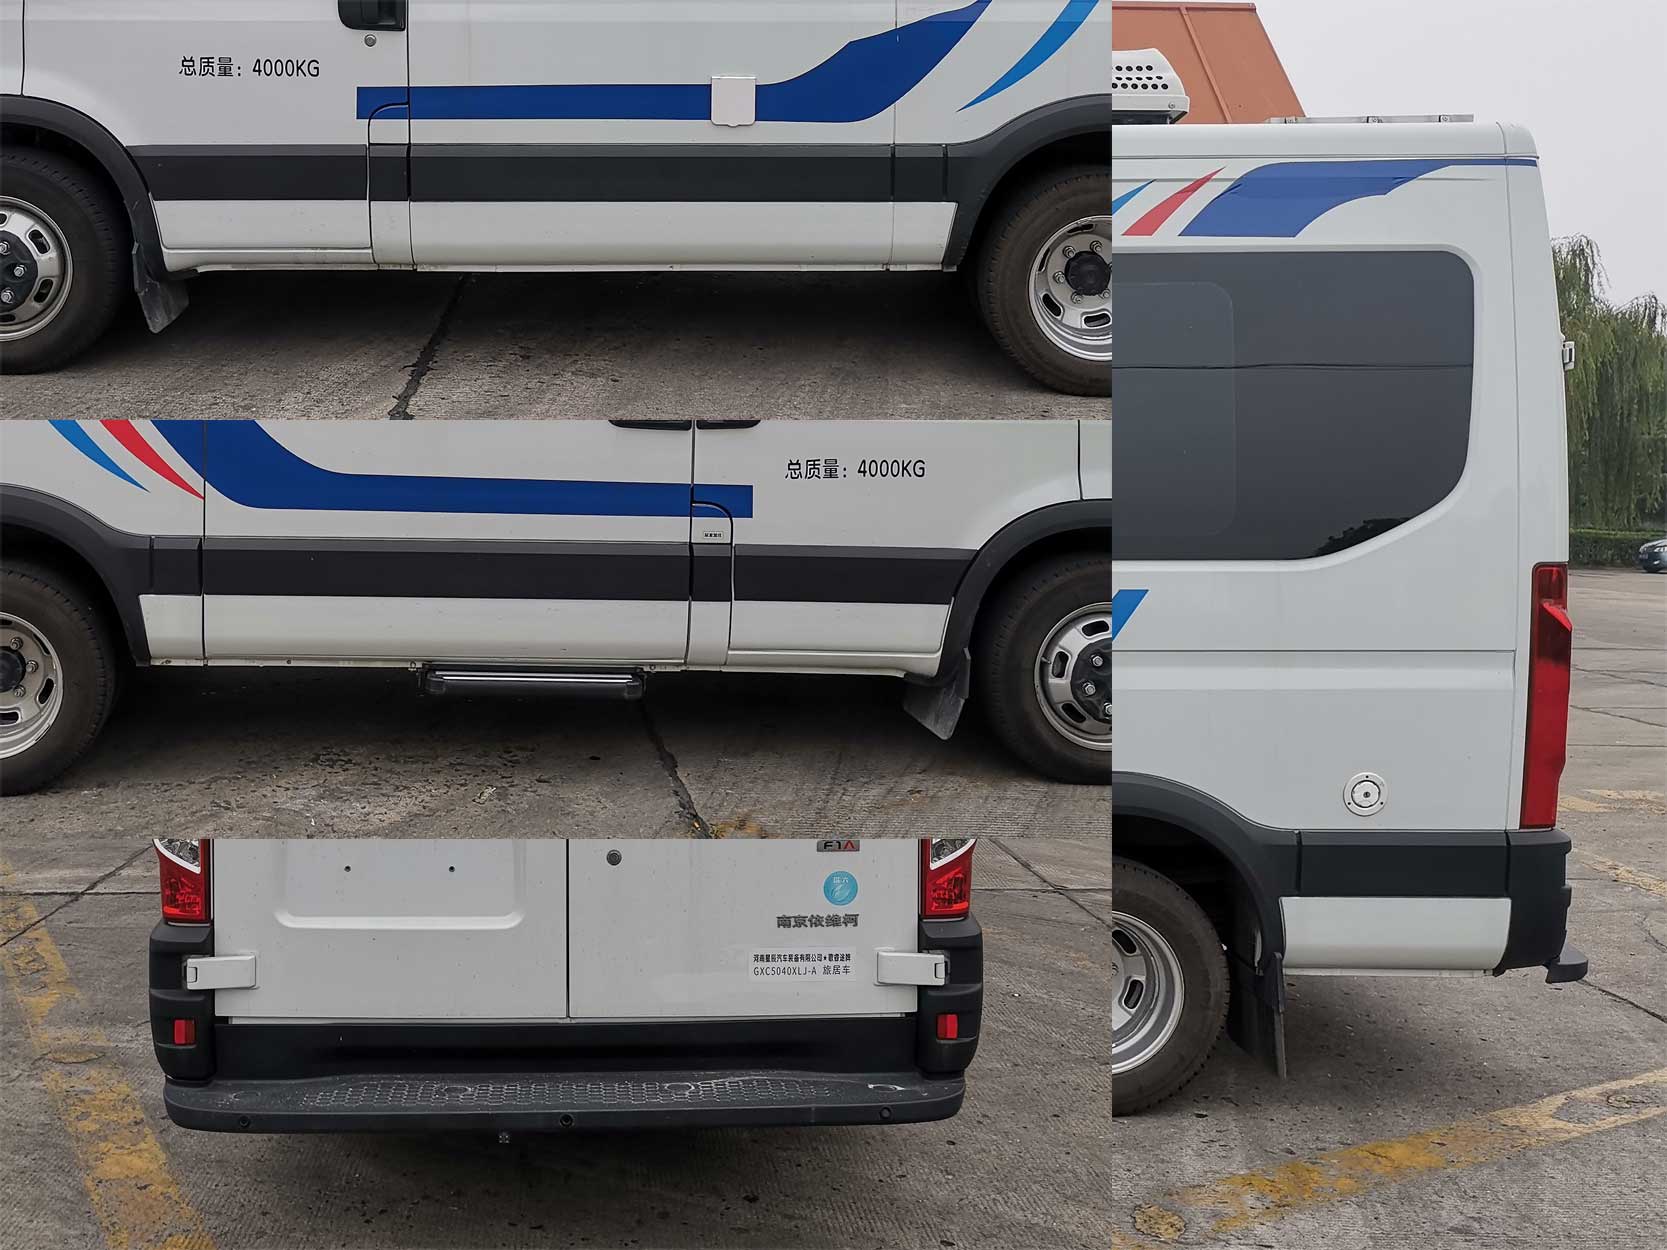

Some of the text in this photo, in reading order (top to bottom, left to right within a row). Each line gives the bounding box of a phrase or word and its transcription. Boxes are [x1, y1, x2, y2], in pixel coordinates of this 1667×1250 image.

[776, 914, 860, 928] 南京依维柯
[753, 965, 851, 976] GXC5040XLJ-A 旅居车
